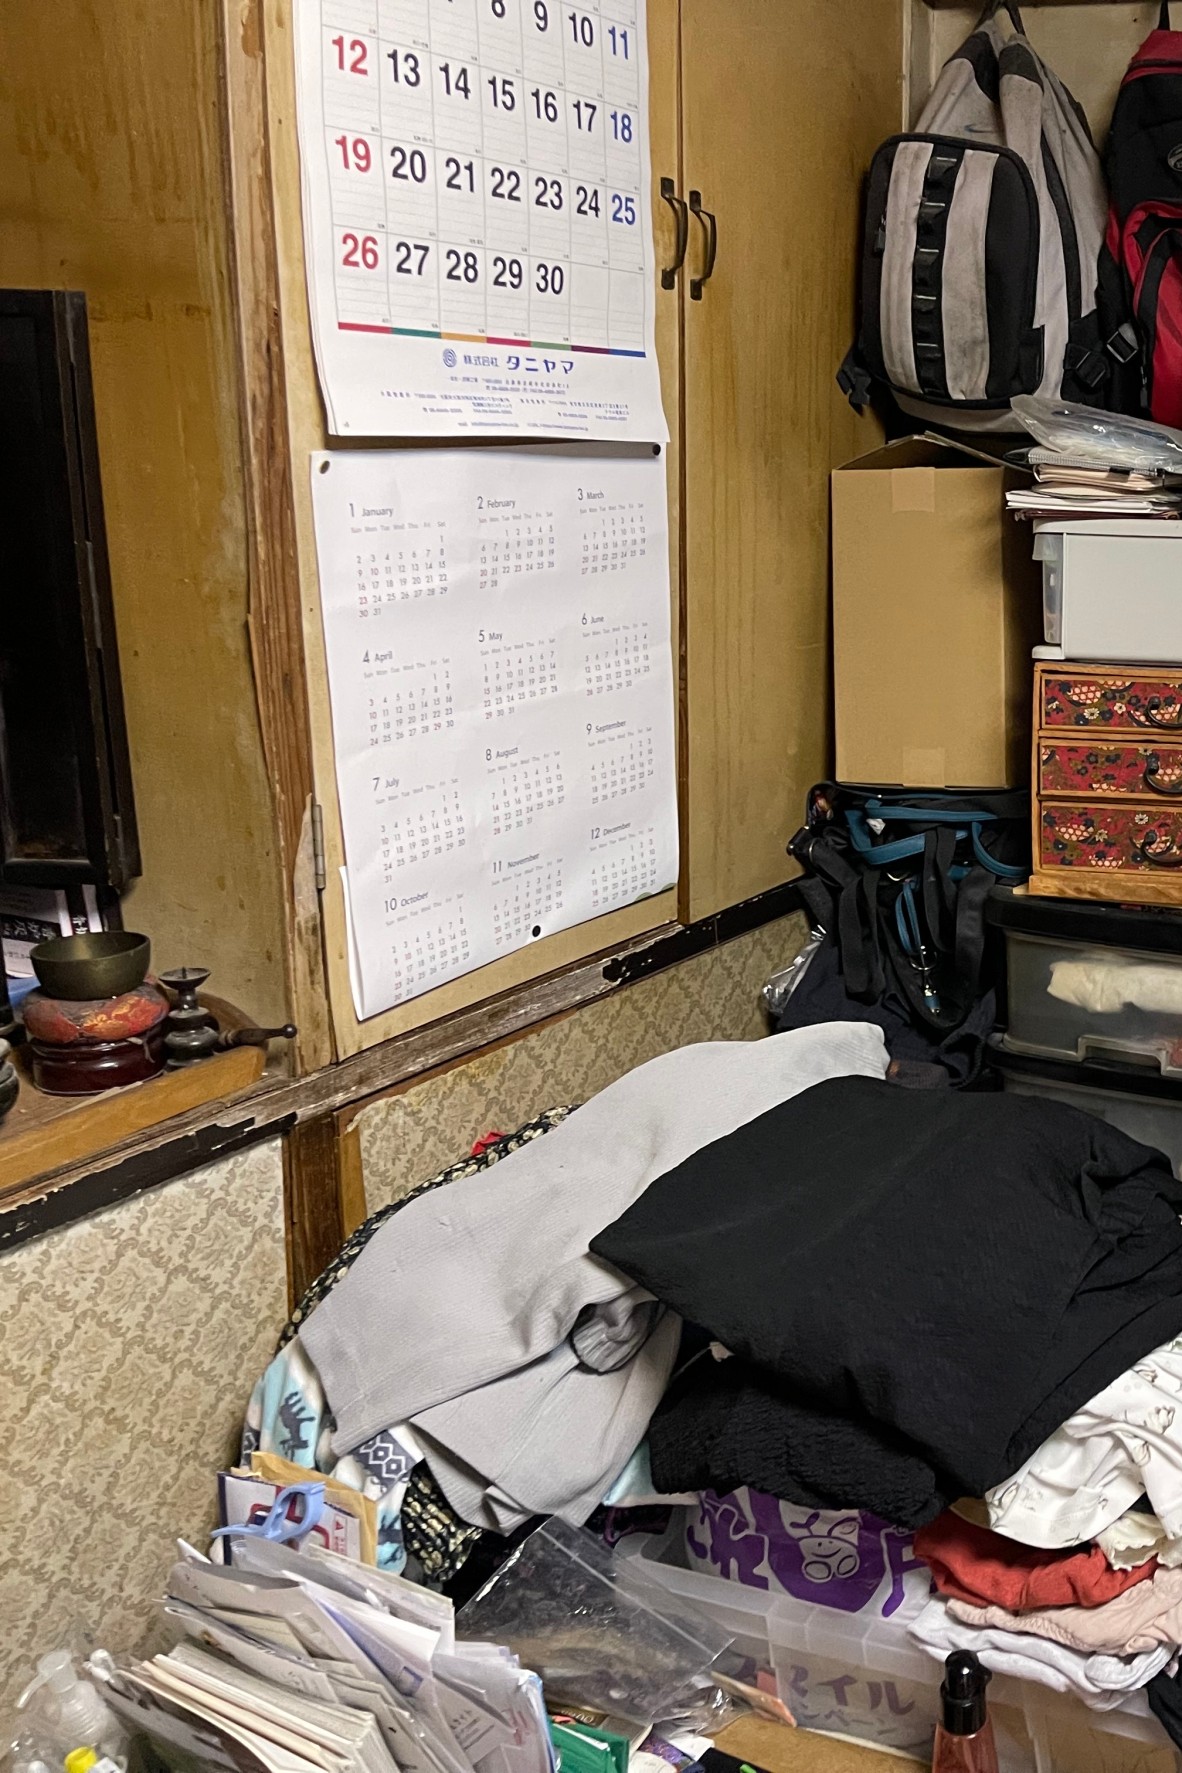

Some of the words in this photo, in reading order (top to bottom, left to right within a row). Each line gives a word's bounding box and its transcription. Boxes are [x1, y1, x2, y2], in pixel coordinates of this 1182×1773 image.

[534, 1, 548, 32] 9
[569, 13, 593, 47] 10
[608, 26, 628, 60] 11
[332, 36, 368, 75] 12
[387, 49, 420, 87] 13
[439, 63, 471, 99] 14
[488, 76, 515, 111] 15
[531, 88, 557, 122] 16
[573, 100, 596, 132] 17
[610, 111, 632, 143] 18
[336, 136, 371, 172] 19
[391, 147, 426, 183] 20
[446, 158, 474, 192] 21
[491, 167, 521, 202] 22
[535, 177, 563, 210] 23
[576, 186, 600, 218] 24
[612, 194, 635, 225] 25
[342, 233, 378, 269] 26
[396, 242, 429, 275] 27
[446, 249, 478, 283] 28
[493, 257, 522, 289] 29
[536, 263, 563, 295] 30
[463, 354, 499, 368] 株式会社
[506, 355, 575, 375] タニヤマ
[577, 488, 584, 501] 3
[586, 491, 605, 501] March
[477, 496, 484, 509] 2
[487, 500, 516, 509] February
[349, 503, 355, 518] 1
[361, 508, 394, 517] January
[581, 613, 588, 625] 6
[590, 615, 605, 624] June
[478, 630, 485, 642] 5
[488, 632, 503, 641] May
[362, 649, 370, 663] 4
[374, 650, 393, 663] April
[586, 723, 592, 735] 9
[595, 720, 626, 734] September
[485, 749, 492, 761] 8
[495, 747, 519, 759] August
[372, 777, 380, 791] 7
[385, 777, 400, 788] July
[591, 827, 601, 840] 12
[603, 822, 631, 836] December
[492, 860, 502, 874] 11
[507, 853, 540, 869] November
[384, 897, 398, 913] 10
[400, 891, 429, 906] October
